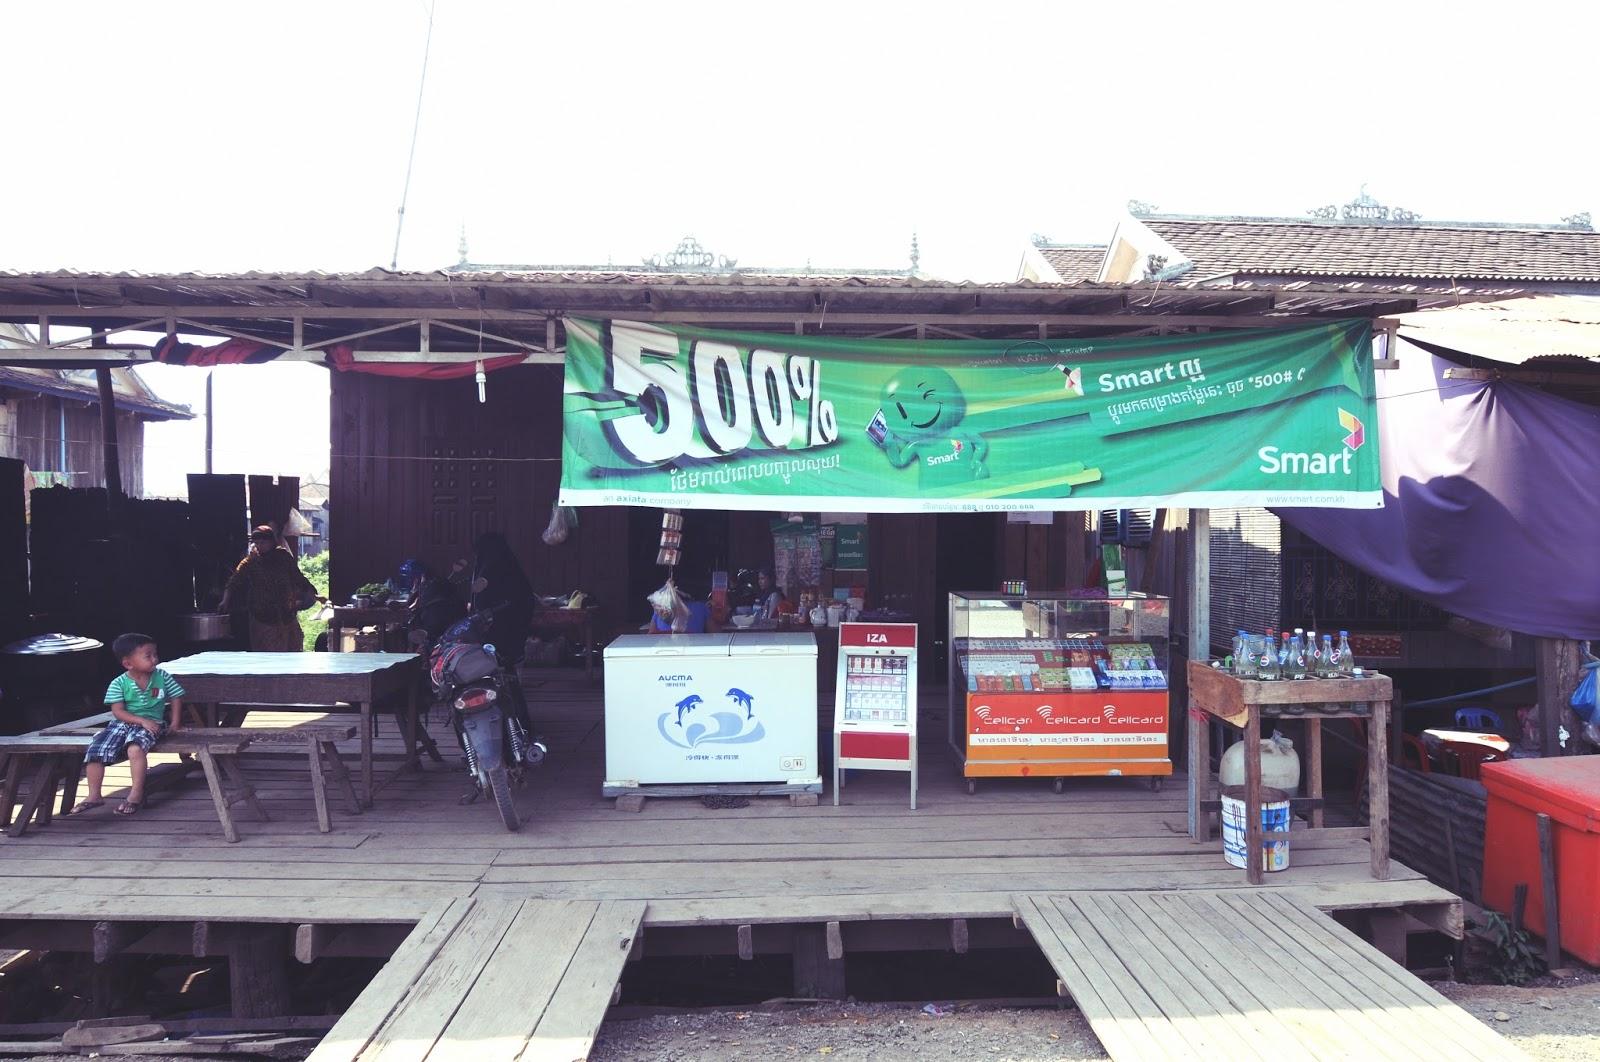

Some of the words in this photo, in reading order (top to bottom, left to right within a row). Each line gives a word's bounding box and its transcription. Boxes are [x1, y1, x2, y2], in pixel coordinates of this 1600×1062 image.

[1098, 362, 1176, 393] Smart
[607, 319, 839, 463] 500%
[927, 451, 960, 467] Smart
[1258, 446, 1352, 476] Smart
[616, 495, 647, 504] axiata
[867, 634, 888, 643] IZA
[1045, 715, 1100, 725] cellcard
[1108, 715, 1163, 725] cellcard
